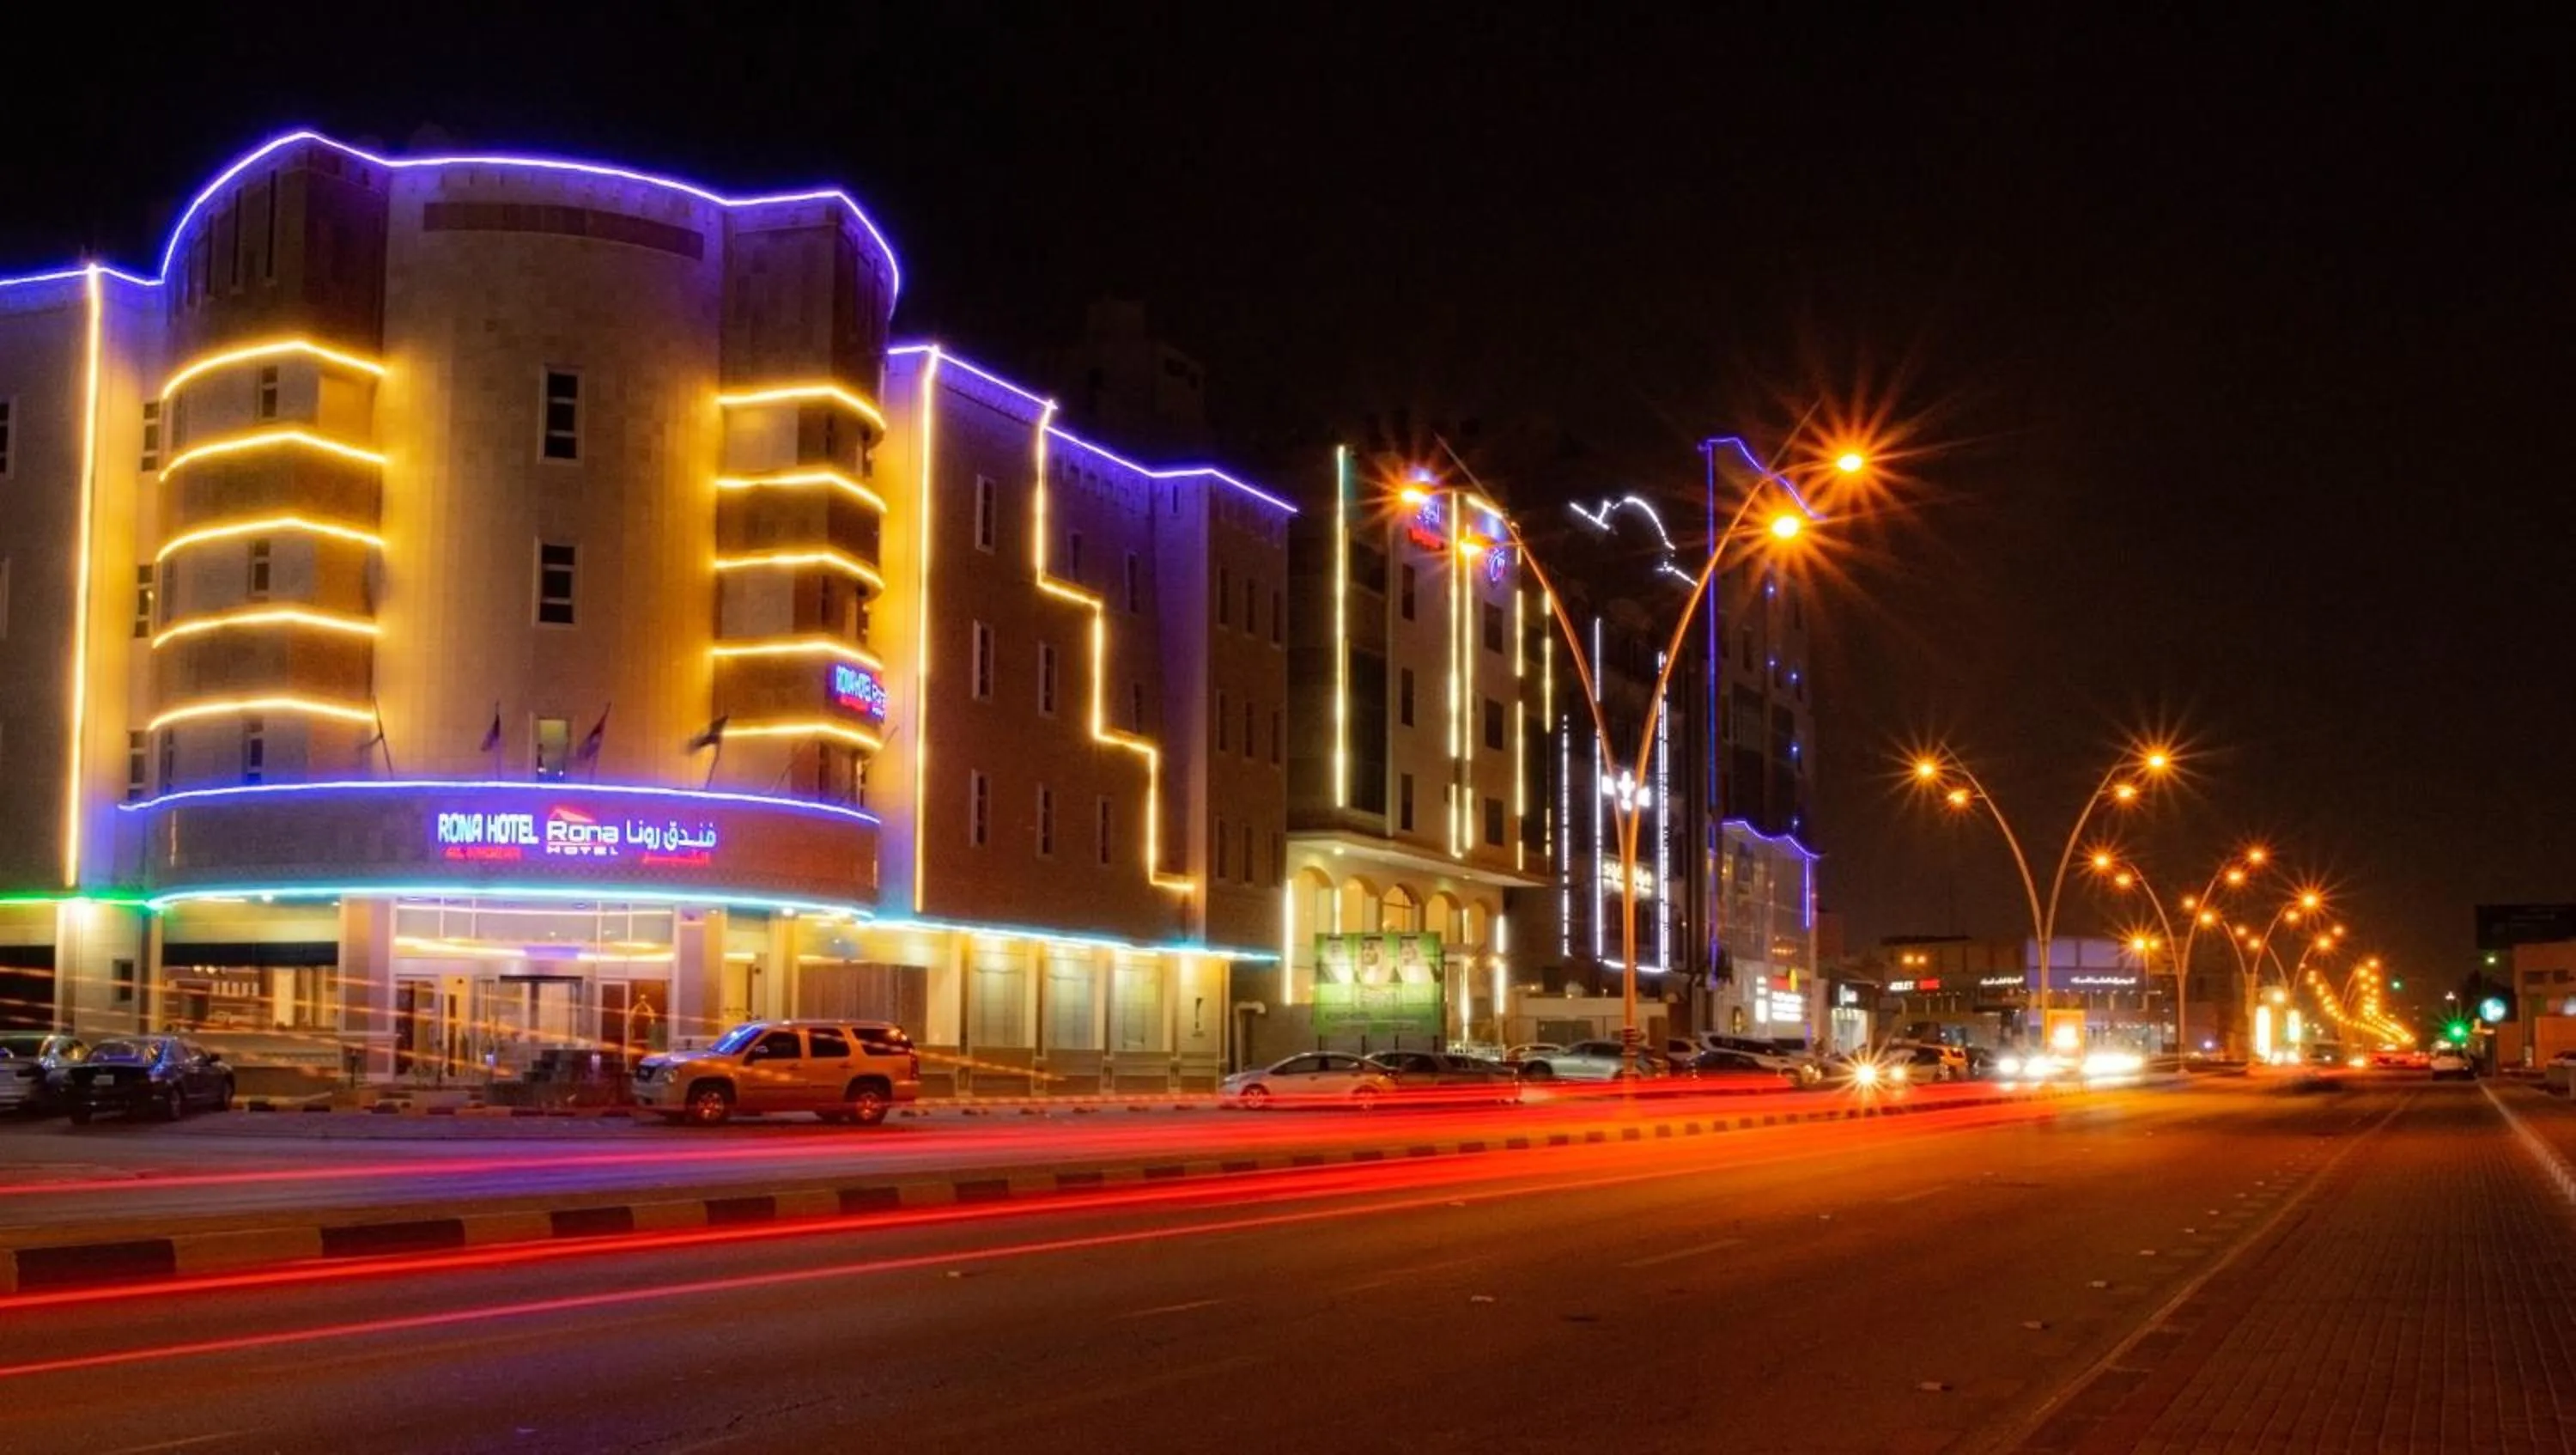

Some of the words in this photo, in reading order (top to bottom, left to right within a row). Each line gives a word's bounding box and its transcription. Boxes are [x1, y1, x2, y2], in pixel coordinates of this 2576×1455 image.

[438, 813, 483, 843] RONA
[487, 813, 539, 844] HOTEL
[546, 820, 619, 843] Rona
[626, 819, 661, 849] رونا
[663, 820, 717, 850] فندق
[546, 846, 619, 855] HOTEL
